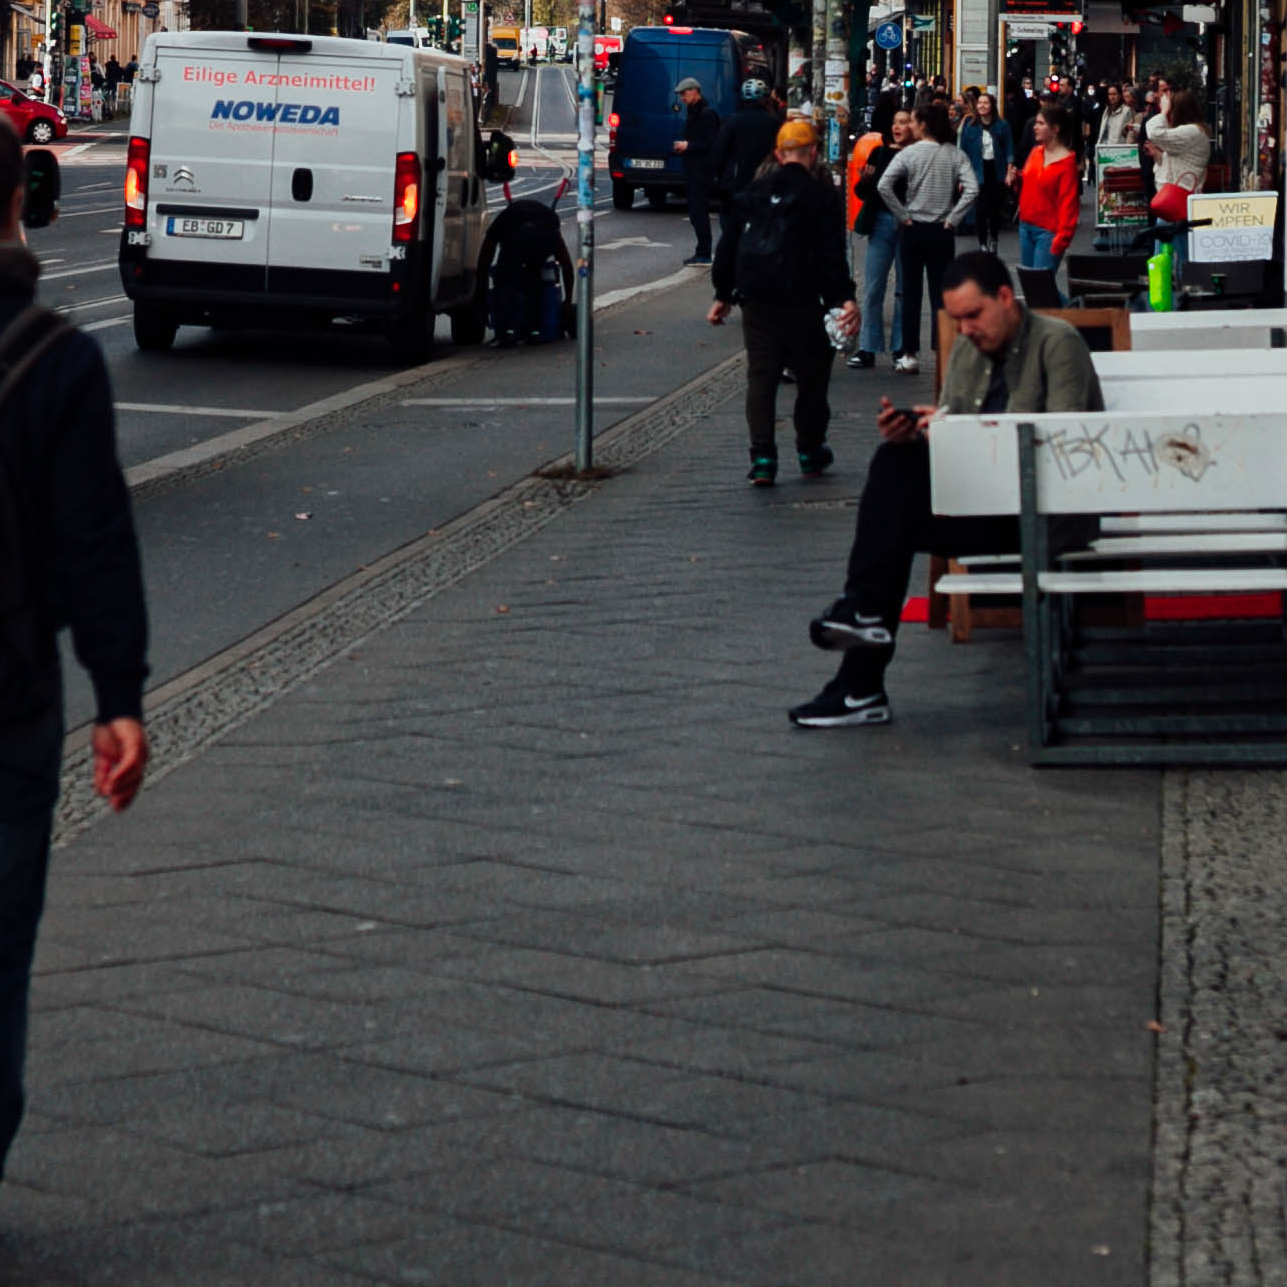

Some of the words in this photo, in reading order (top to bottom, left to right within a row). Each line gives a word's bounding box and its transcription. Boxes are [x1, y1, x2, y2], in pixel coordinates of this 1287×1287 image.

[183, 66, 237, 86] Eilige
[244, 70, 376, 92] Arzneimittel!
[210, 100, 340, 125] NOWEDA
[1219, 202, 1249, 214] WIR
[1210, 214, 1264, 227] MPFEN
[1200, 232, 1272, 248] COVID-19
